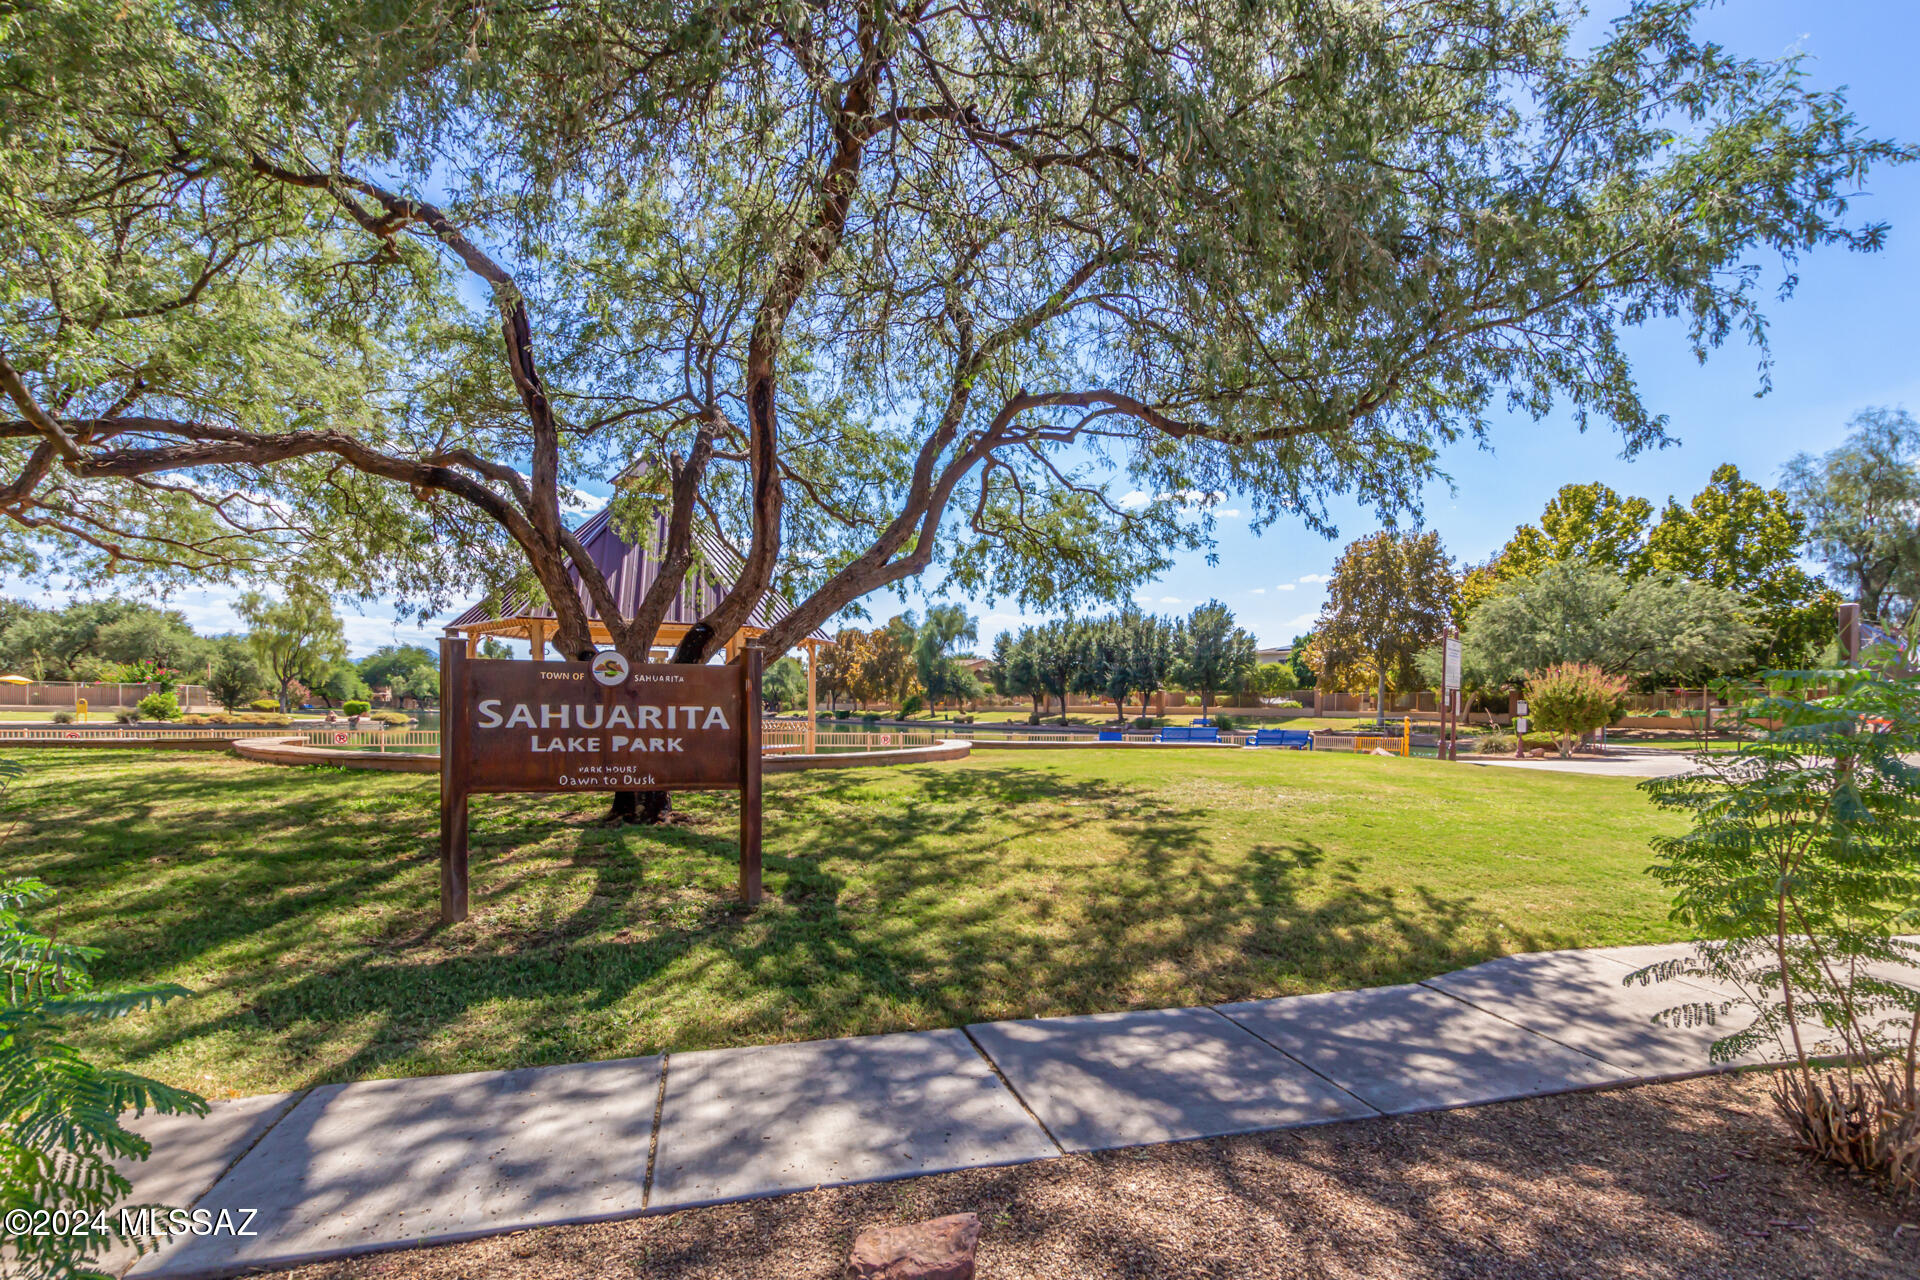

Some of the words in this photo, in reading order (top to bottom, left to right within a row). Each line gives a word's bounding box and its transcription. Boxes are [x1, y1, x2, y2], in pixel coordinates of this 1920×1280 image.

[540, 671, 570, 680] TOWN
[572, 672, 585, 681] OF
[634, 674, 684, 683] SAHUARITA
[478, 699, 730, 730] SAHUARITA
[531, 735, 600, 752] LAKE
[612, 736, 684, 752] PARK
[559, 775, 598, 785] Dawn
[603, 777, 617, 785] to
[623, 774, 655, 785] Dusk
